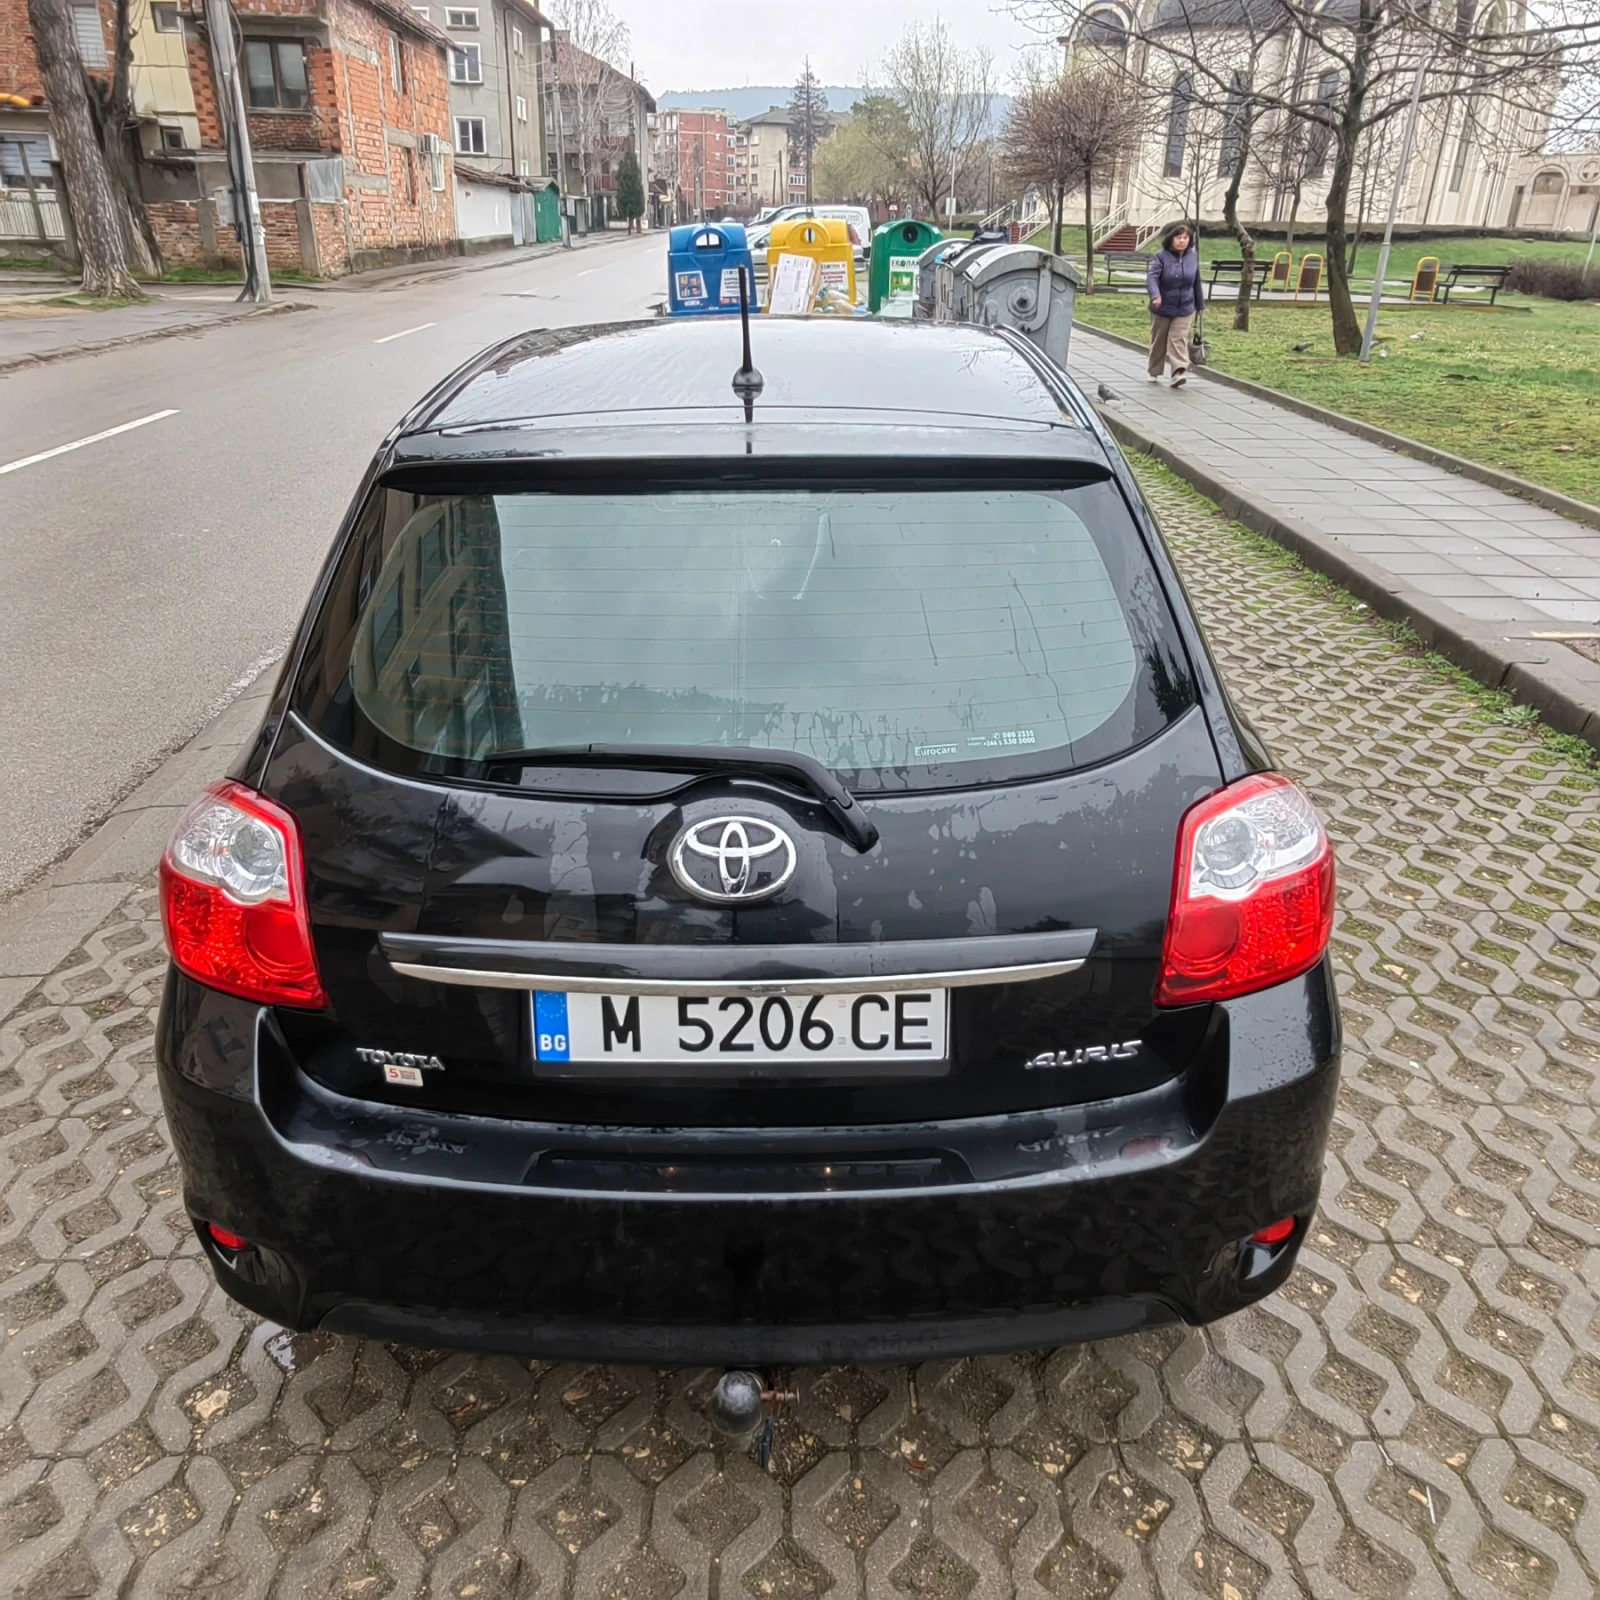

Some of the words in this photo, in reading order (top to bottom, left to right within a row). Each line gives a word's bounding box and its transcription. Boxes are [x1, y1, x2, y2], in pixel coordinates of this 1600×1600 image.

[914, 744, 957, 756] Eurocare
[601, 995, 642, 1052] M
[678, 995, 834, 1051] 5206
[850, 993, 932, 1051] CE
[540, 1034, 567, 1051] BG
[1024, 1039, 1143, 1070] AURIS
[355, 1047, 446, 1071] TOYOTA
